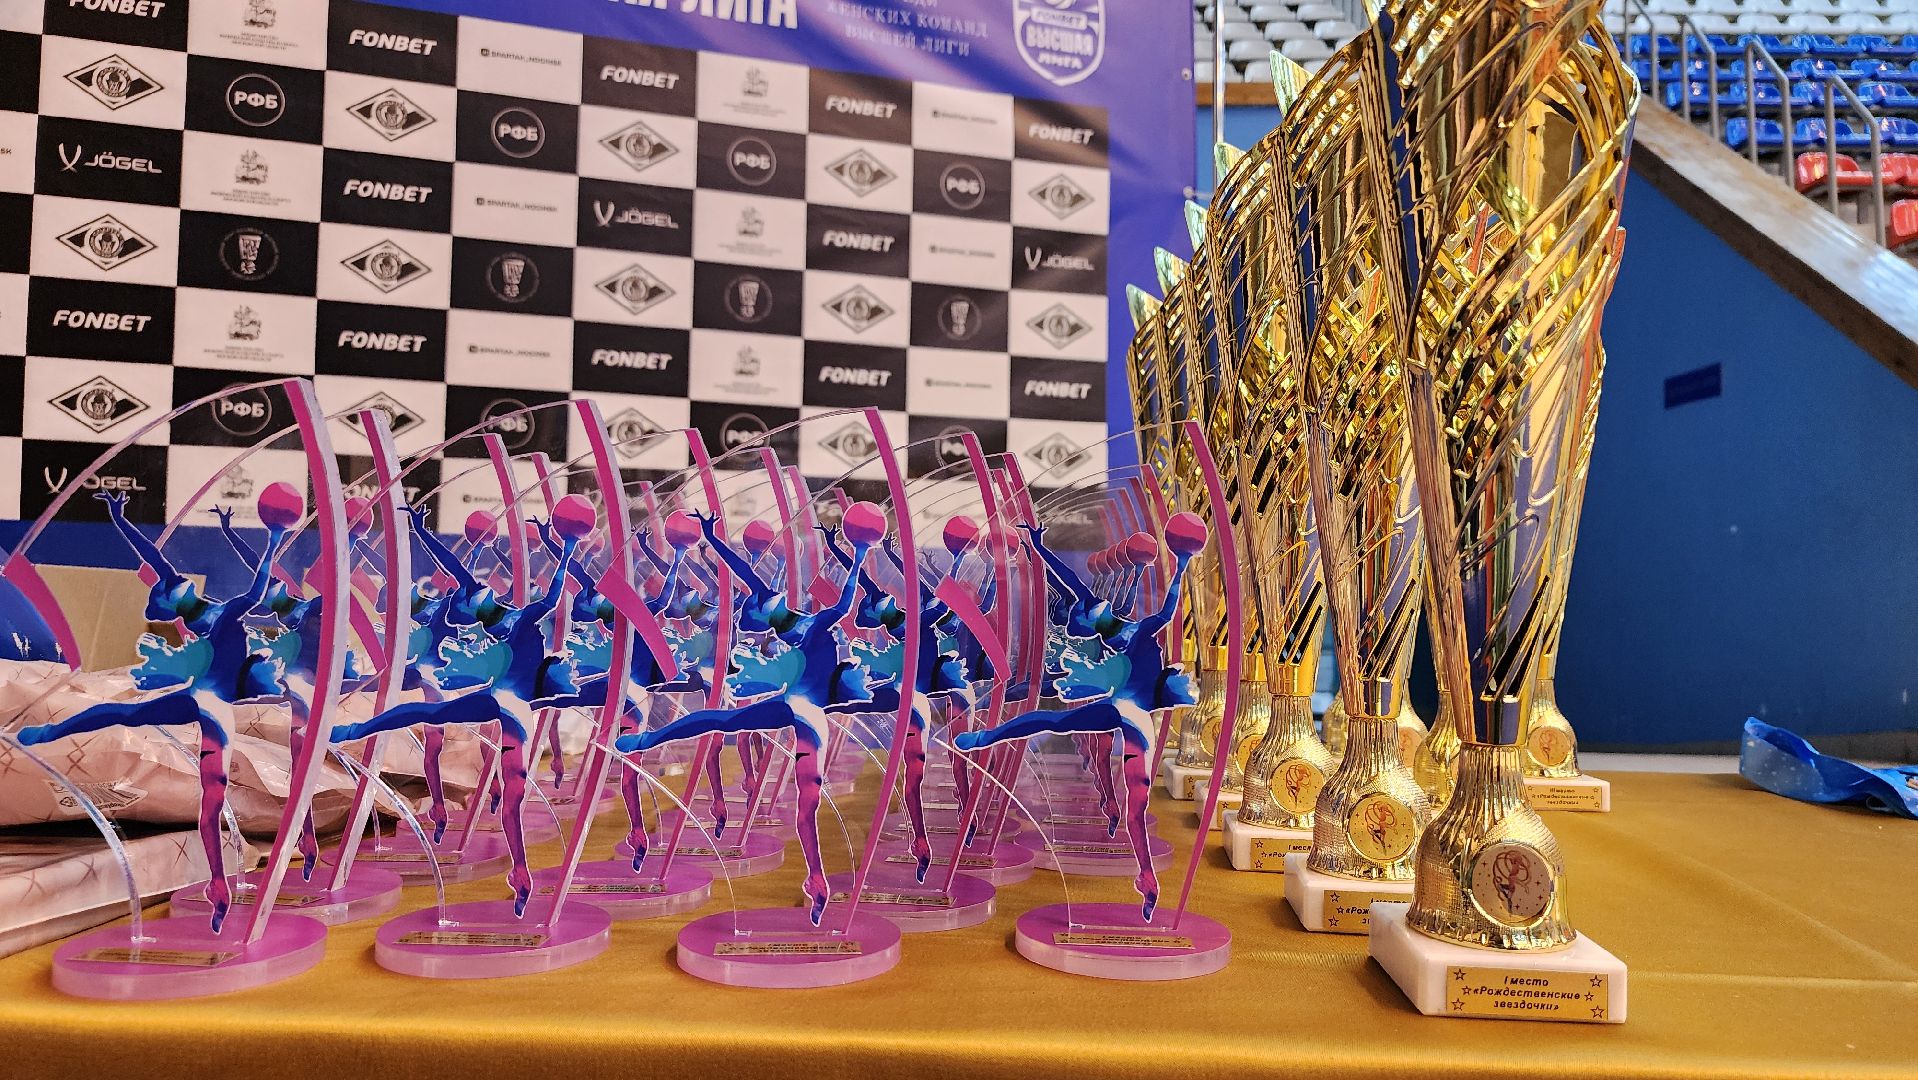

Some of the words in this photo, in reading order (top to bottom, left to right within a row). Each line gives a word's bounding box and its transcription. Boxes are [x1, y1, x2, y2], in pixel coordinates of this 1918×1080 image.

[349, 29, 437, 56] FONBET
[601, 65, 680, 89] FONBET
[234, 91, 278, 109] РФБ
[825, 95, 898, 119] FONBET
[499, 123, 538, 141] РФБ
[1028, 123, 1095, 145] FONBET
[85, 151, 163, 174] JÖGEL
[734, 152, 771, 169] РФБ
[343, 179, 432, 203] FONBET
[615, 207, 679, 229] JÖGEL
[823, 230, 895, 252] FONBET
[53, 310, 151, 333] FONBET
[338, 330, 427, 353] FONBET
[591, 349, 672, 371] FONBET
[819, 366, 892, 388] FONBET
[1025, 380, 1092, 400] FONBET
[220, 400, 265, 418] РФБ
[1504, 976, 1509, 984] I
[1510, 977, 1549, 987] место
[1473, 986, 1581, 1000] «Рождественские
[1493, 1000, 1560, 1011] звездочки»
